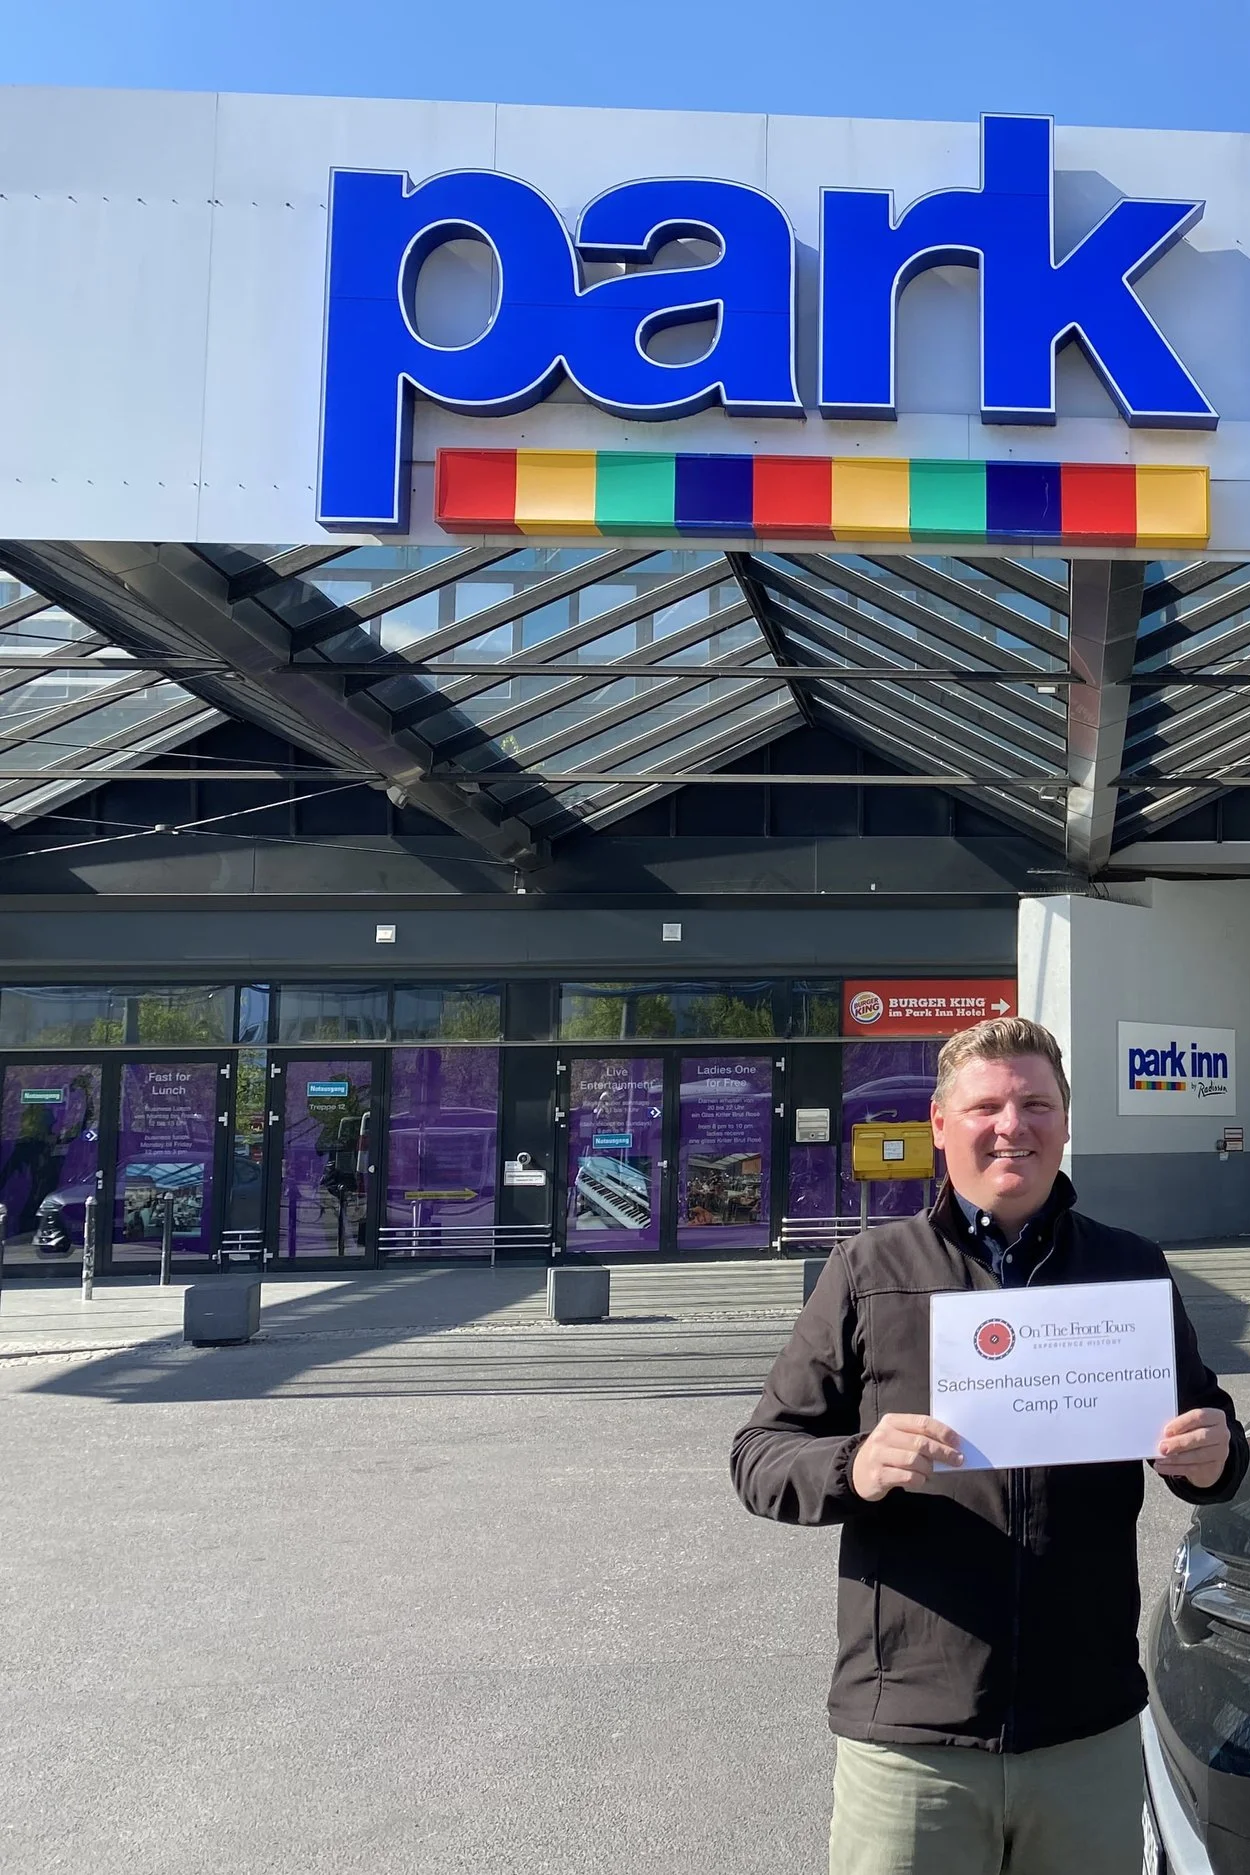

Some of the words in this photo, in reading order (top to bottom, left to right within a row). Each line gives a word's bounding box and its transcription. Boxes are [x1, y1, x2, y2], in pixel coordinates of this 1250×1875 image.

[316, 112, 1220, 529] park
[888, 998, 947, 1008] BURGER
[950, 997, 986, 1008] KING
[854, 1004, 880, 1017] KING
[888, 1009, 902, 1017] im
[905, 1008, 932, 1017] Park
[935, 1008, 953, 1017] Inn
[956, 1008, 986, 1017] Hotel
[697, 1065, 732, 1075] Ladies
[734, 1065, 757, 1074] One
[1128, 1041, 1187, 1090] park
[1191, 1043, 1228, 1079] inn
[148, 1072, 172, 1082] Fast
[175, 1072, 191, 1081] for
[606, 1067, 628, 1077] Live
[580, 1081, 654, 1090] Entertainment
[706, 1078, 720, 1087] for
[724, 1078, 747, 1087] Free
[152, 1086, 186, 1095] Lunch
[1197, 1080, 1228, 1099] Radisson
[309, 1103, 336, 1111] Treppe
[1019, 1325, 1041, 1339] On
[1041, 1323, 1069, 1337] The
[1069, 1321, 1101, 1336] Front
[1101, 1320, 1136, 1334] Tours
[1033, 1340, 1083, 1350] EXPERIENCE
[1087, 1338, 1122, 1348] HISTORY
[937, 1372, 1060, 1393] Sachsenhausen
[1065, 1366, 1171, 1386] Concentration
[1012, 1397, 1059, 1413] Camp
[1063, 1395, 1098, 1410] Tour
